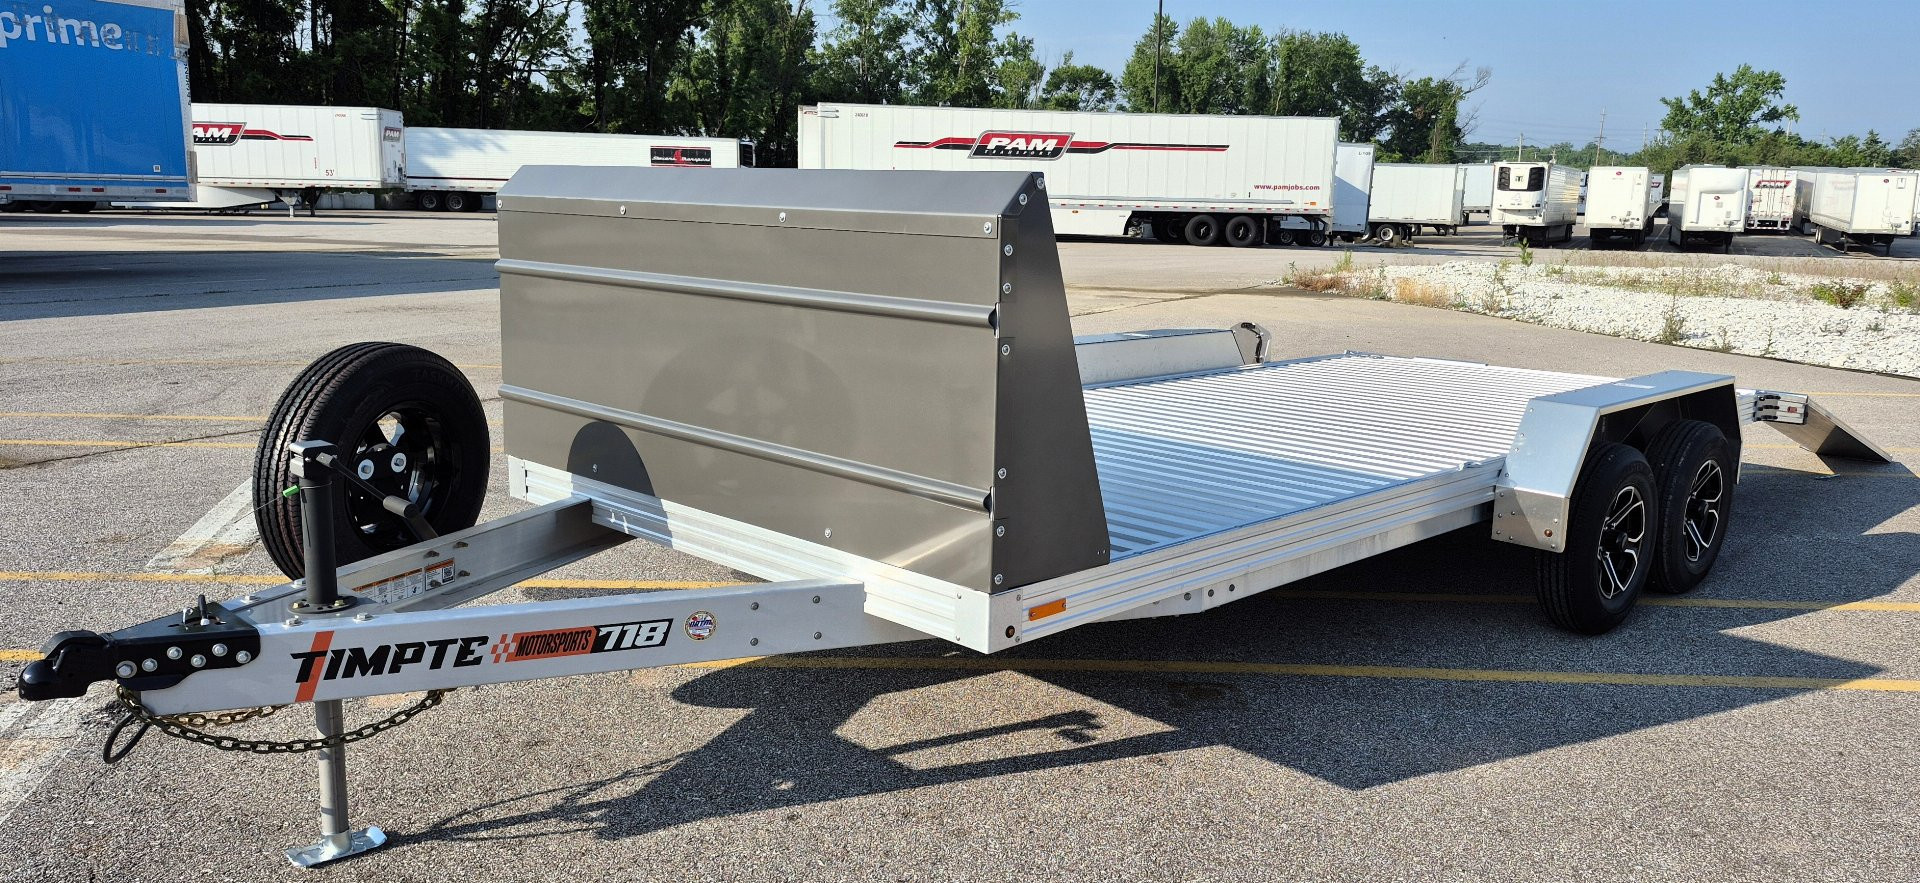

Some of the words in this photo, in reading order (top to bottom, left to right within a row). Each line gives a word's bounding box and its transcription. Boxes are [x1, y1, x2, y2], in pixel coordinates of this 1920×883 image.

[0, 5, 123, 49] prime
[385, 129, 400, 138] PAM
[986, 137, 1059, 151] PAM
[984, 148, 1053, 156] TRANSPORT
[514, 629, 592, 657] MOTORSPORTS
[598, 621, 670, 651] 718
[290, 635, 489, 683] TIMPTE
